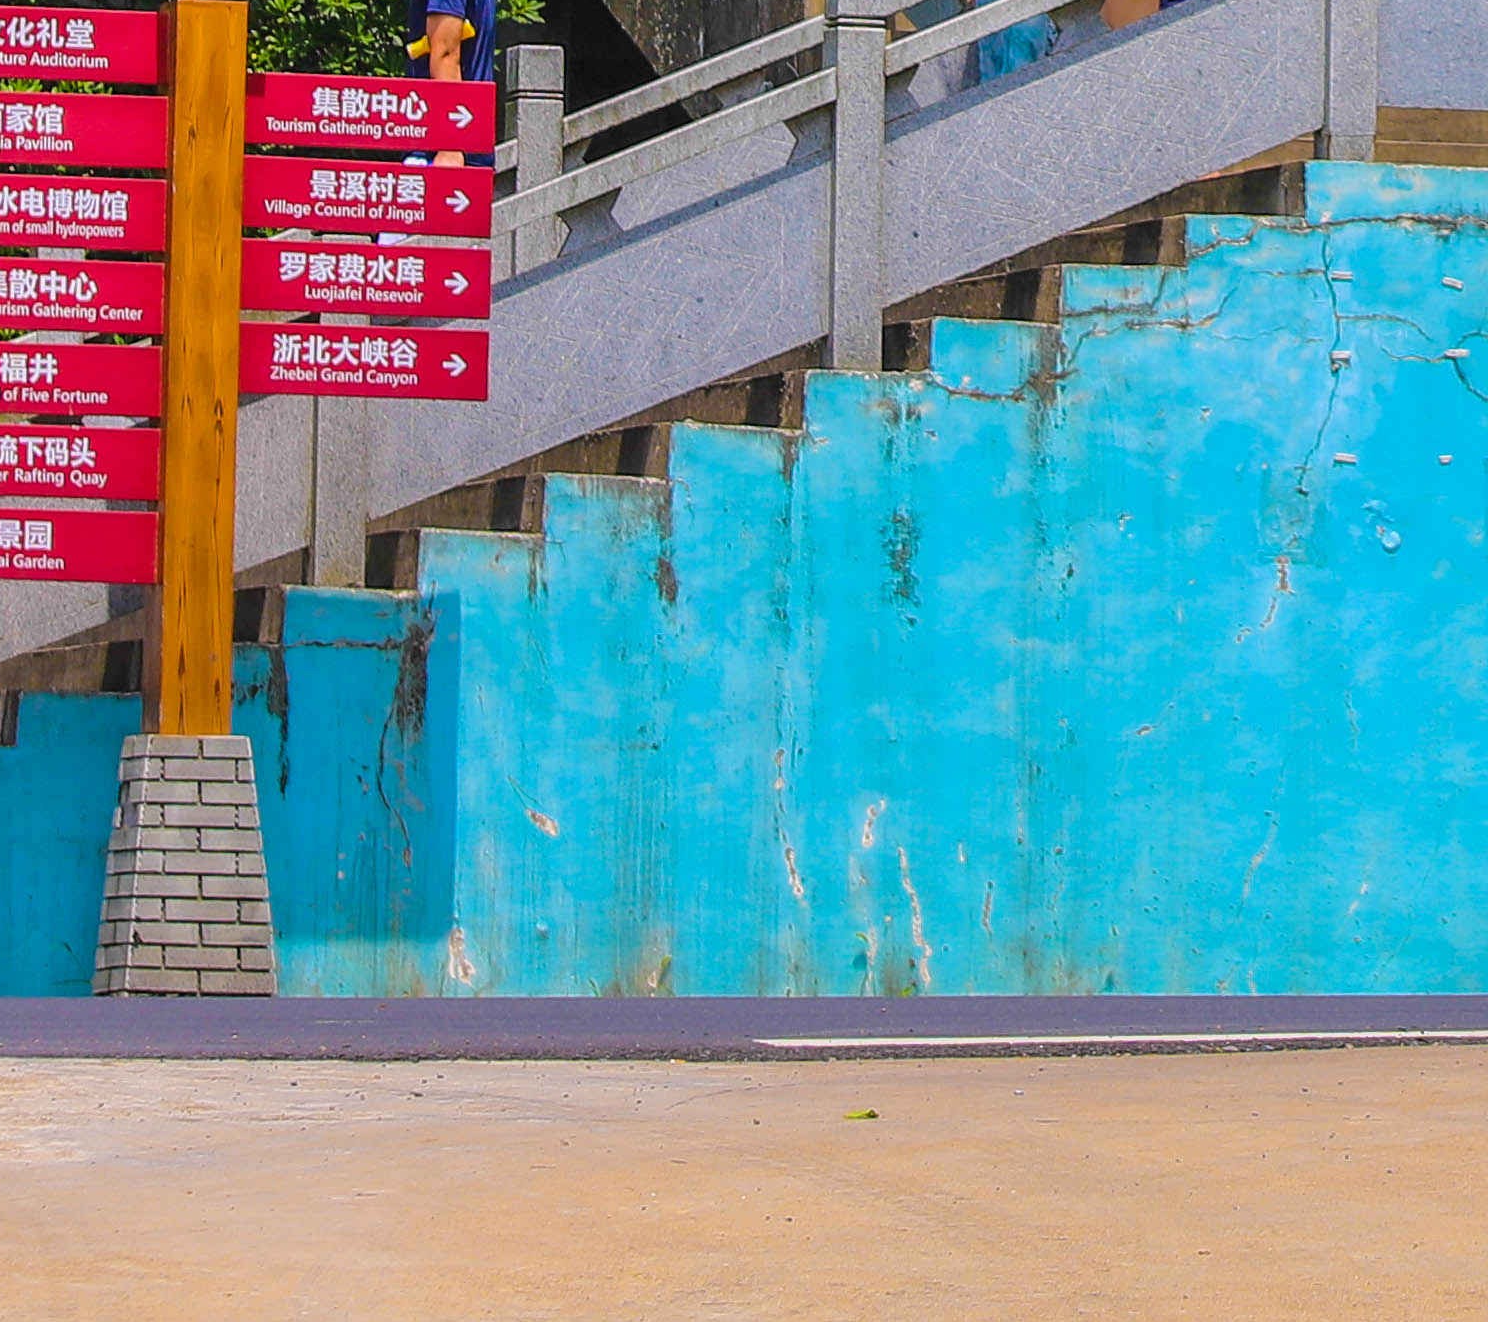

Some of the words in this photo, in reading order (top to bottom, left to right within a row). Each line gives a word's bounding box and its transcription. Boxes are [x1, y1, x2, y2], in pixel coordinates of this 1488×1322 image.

[29, 51, 109, 69] Auditorium
[312, 87, 428, 121] 集散中心
[266, 116, 317, 133] Tourism
[318, 118, 382, 140] Gathering
[384, 122, 428, 139] Center
[15, 135, 74, 152] Pavillion
[309, 169, 427, 205] 景溪村委
[264, 199, 312, 219] Village
[314, 202, 366, 220] Council
[368, 204, 385, 220] of
[385, 204, 426, 225] Jingxi
[12, 218, 26, 235] of
[26, 219, 54, 236] small
[55, 220, 126, 240] hydropowers
[278, 251, 426, 286] 罗家费水库
[304, 286, 363, 304] Luojiafei
[365, 287, 424, 304] Resevoir
[32, 302, 97, 323] Gathering
[99, 305, 144, 322] Center
[272, 333, 419, 369] 浙北大峡谷
[269, 365, 318, 382] Zhebei
[320, 366, 364, 383] Grand
[366, 369, 419, 386] Canyon
[2, 387, 19, 402] of
[20, 387, 51, 404] Five
[52, 389, 109, 406] Fortune
[14, 468, 65, 488] Rafting
[70, 471, 108, 489] Quay
[12, 553, 65, 571] Garden
